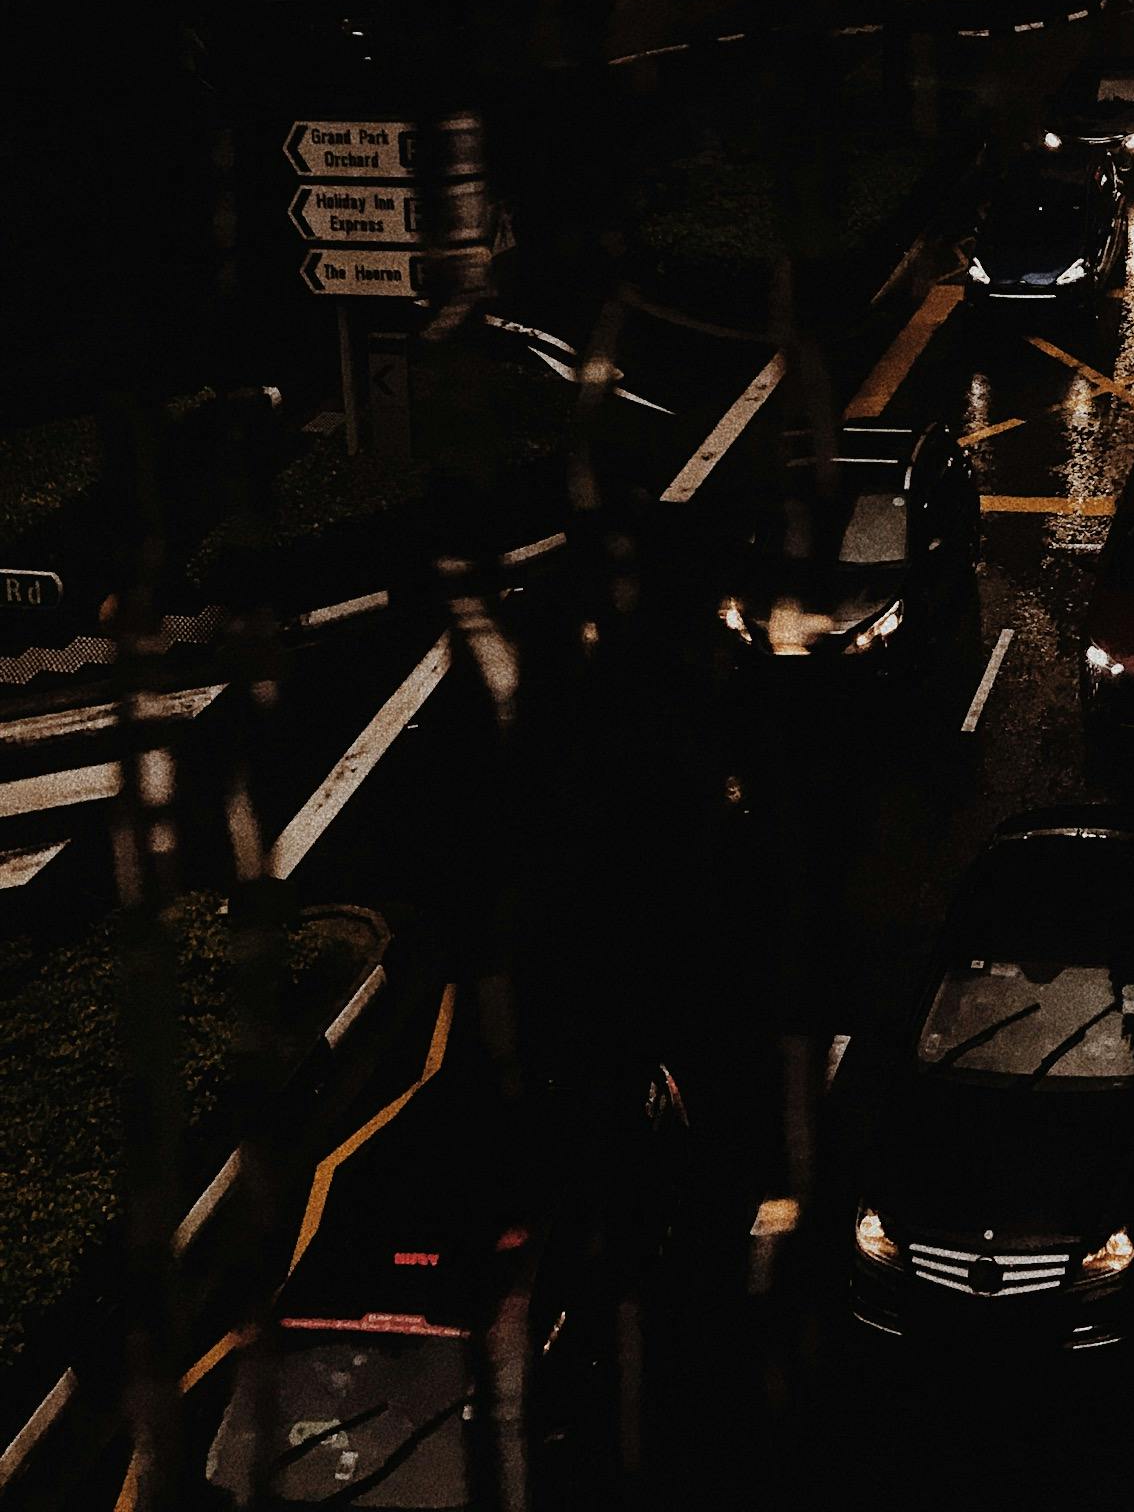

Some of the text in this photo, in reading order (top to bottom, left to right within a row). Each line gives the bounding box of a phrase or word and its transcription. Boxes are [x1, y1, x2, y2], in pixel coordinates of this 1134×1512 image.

[311, 126, 390, 145] Grand Park
[324, 150, 380, 168] Orchard
[315, 192, 396, 214] Holiday Inn
[330, 215, 385, 235] Express
[324, 263, 402, 281] The Heeren
[6, 577, 42, 605] Rd
